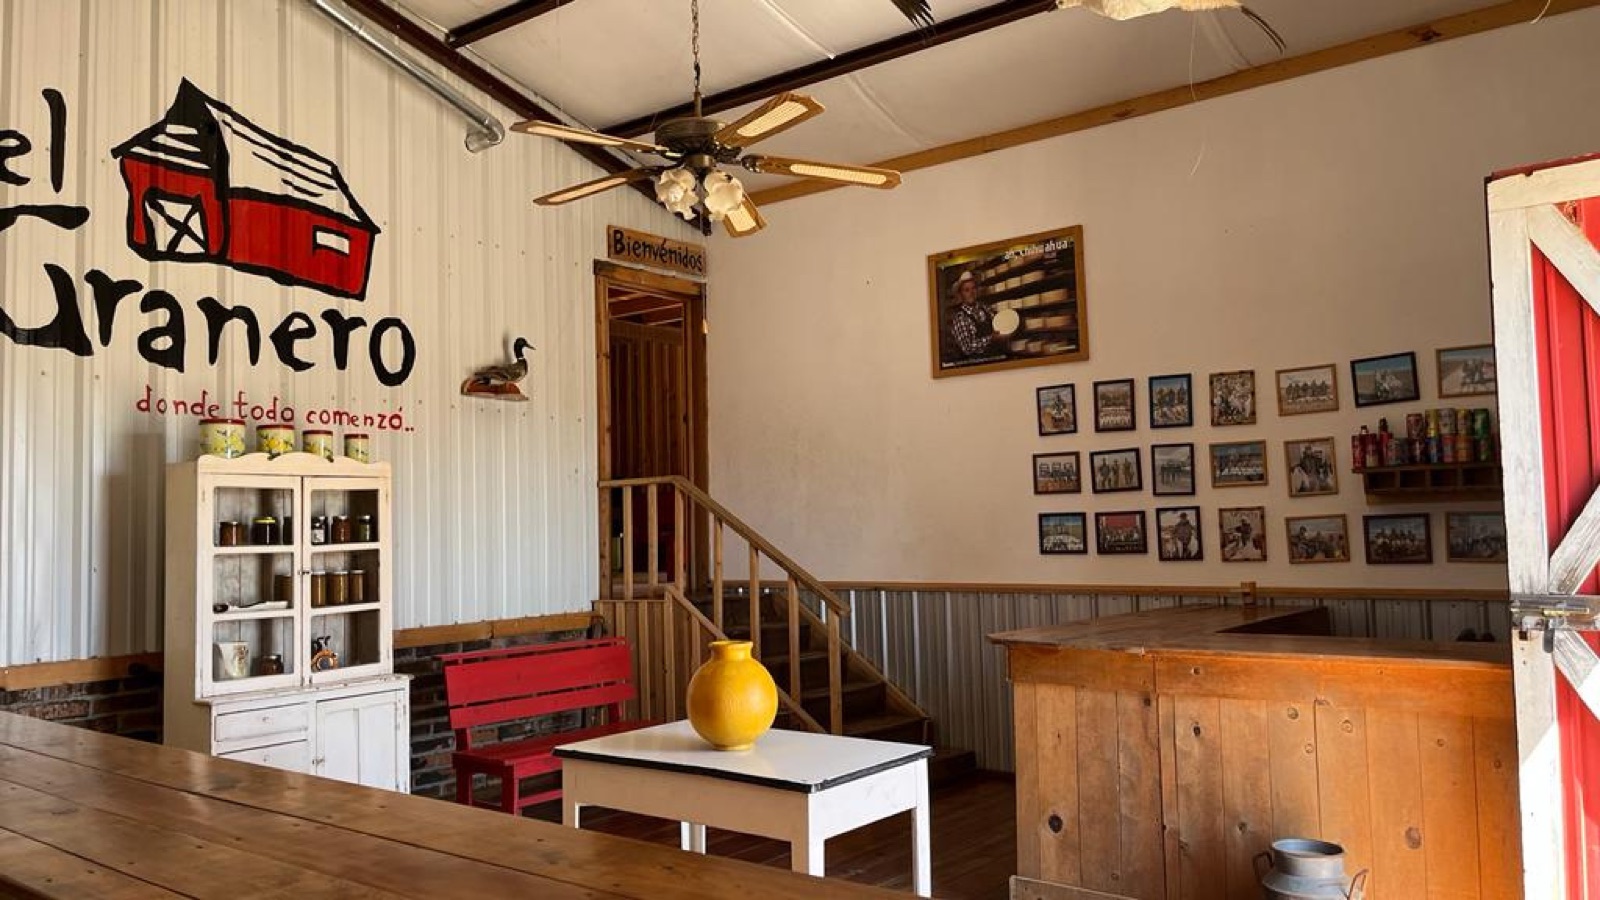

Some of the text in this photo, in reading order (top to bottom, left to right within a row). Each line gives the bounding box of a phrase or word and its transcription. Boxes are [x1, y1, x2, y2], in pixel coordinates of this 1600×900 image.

[0, 88, 67, 194] el
[135, 384, 221, 419] donde
[233, 390, 295, 422] todo
